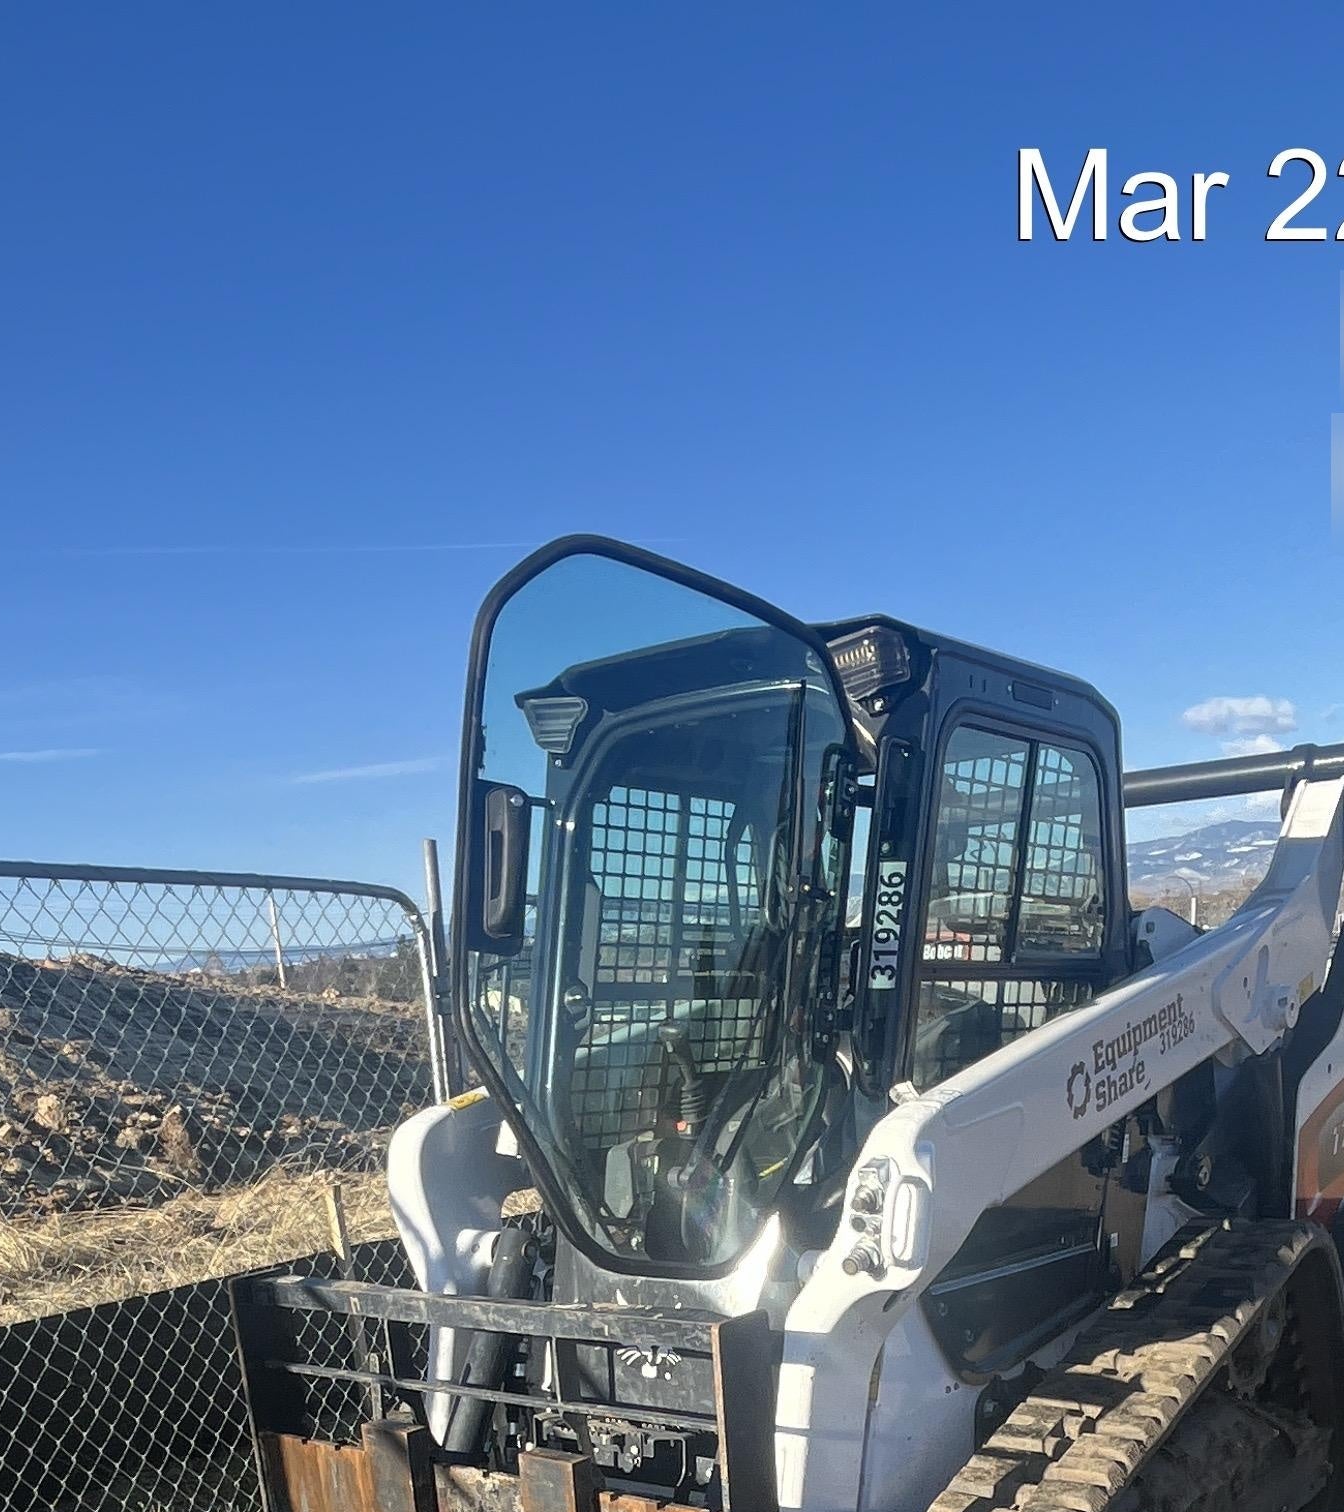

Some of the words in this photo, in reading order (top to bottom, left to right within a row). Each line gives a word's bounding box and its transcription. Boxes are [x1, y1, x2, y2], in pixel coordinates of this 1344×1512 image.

[870, 871, 906, 981] 319286
[1092, 992, 1186, 1075] Equipment
[1159, 1011, 1196, 1055] 319286
[1095, 1059, 1147, 1113] Share
